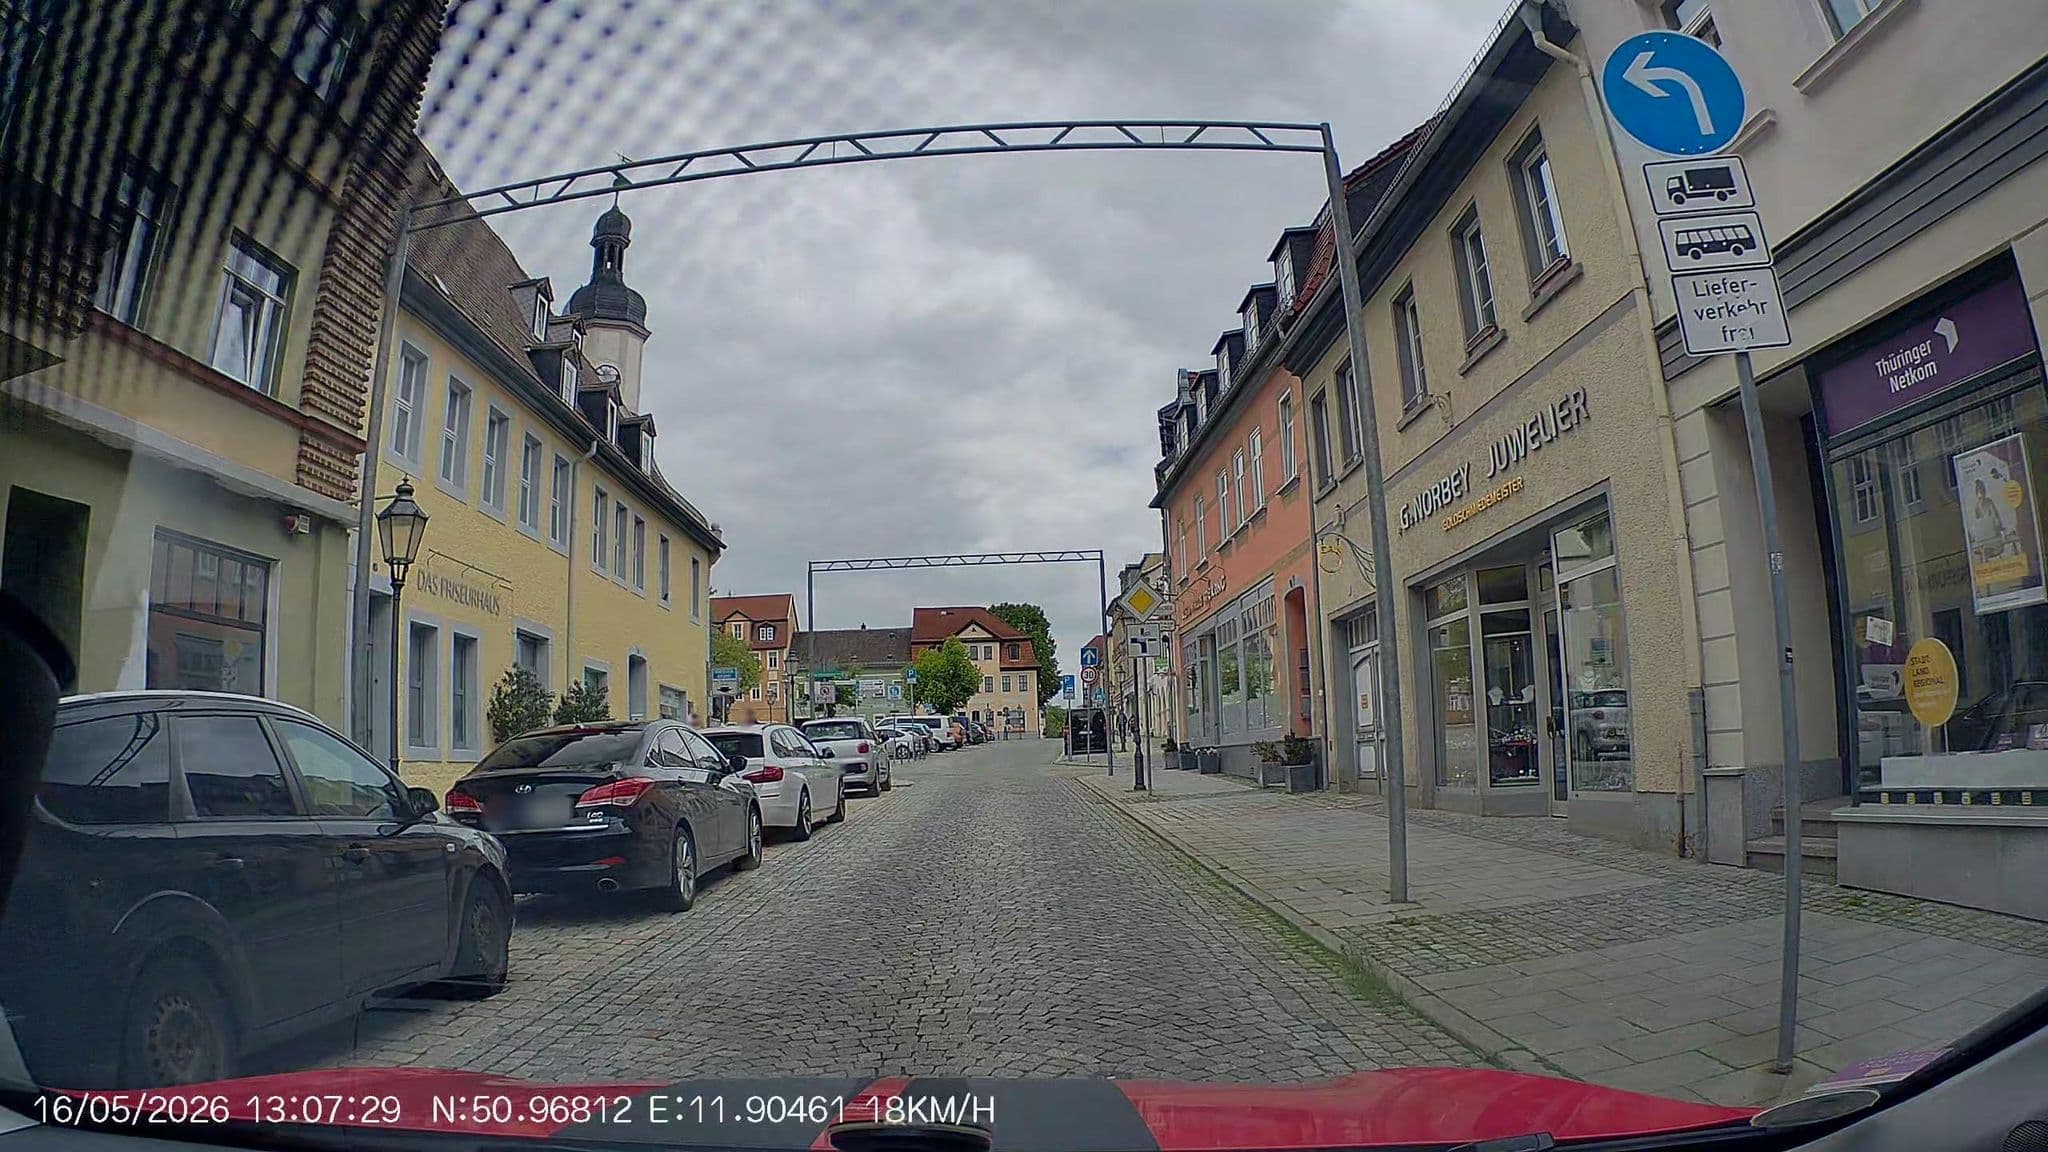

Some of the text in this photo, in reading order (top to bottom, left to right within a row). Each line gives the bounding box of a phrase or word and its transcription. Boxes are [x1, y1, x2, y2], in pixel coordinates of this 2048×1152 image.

[1692, 278, 1758, 298] Liefer-
[1694, 299, 1768, 321] verkehr
[1875, 339, 1934, 378] Thüringer
[1889, 360, 1938, 394] Netkom
[1399, 386, 1590, 530] G.NORBEY JUWELIER
[1442, 476, 1524, 532] GOLDSCHMIEDEMEISTER
[417, 568, 500, 616] DAS FRISEURHAUS
[1084, 671, 1094, 680] 30
